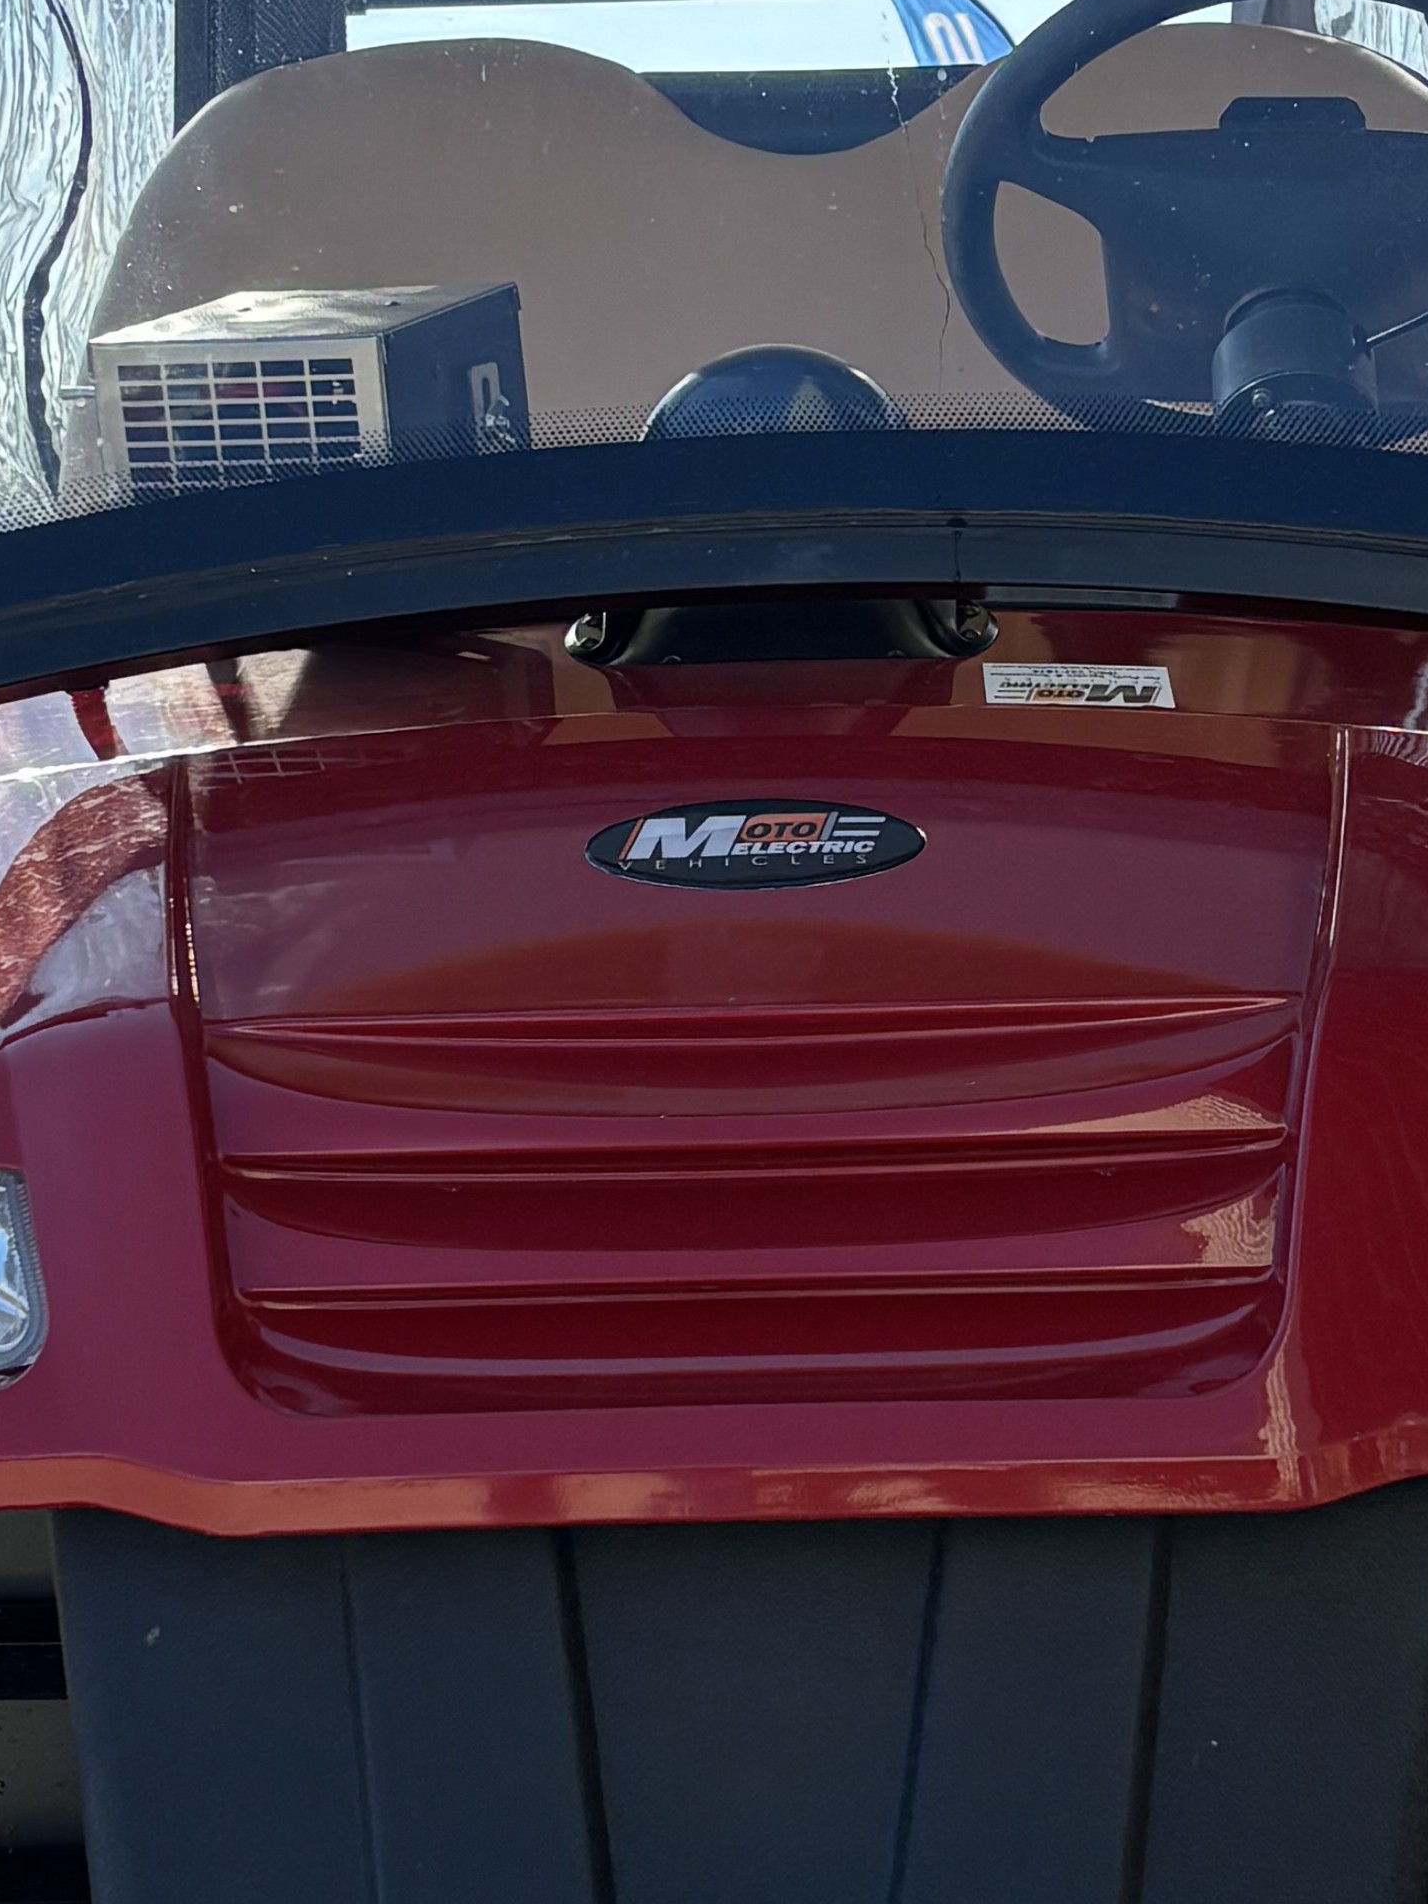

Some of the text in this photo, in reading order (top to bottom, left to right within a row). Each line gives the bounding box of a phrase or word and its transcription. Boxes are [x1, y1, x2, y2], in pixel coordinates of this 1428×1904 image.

[625, 815, 818, 860] MOTO
[733, 840, 876, 856] ELECTRIC
[618, 853, 868, 872] VEHICLES
